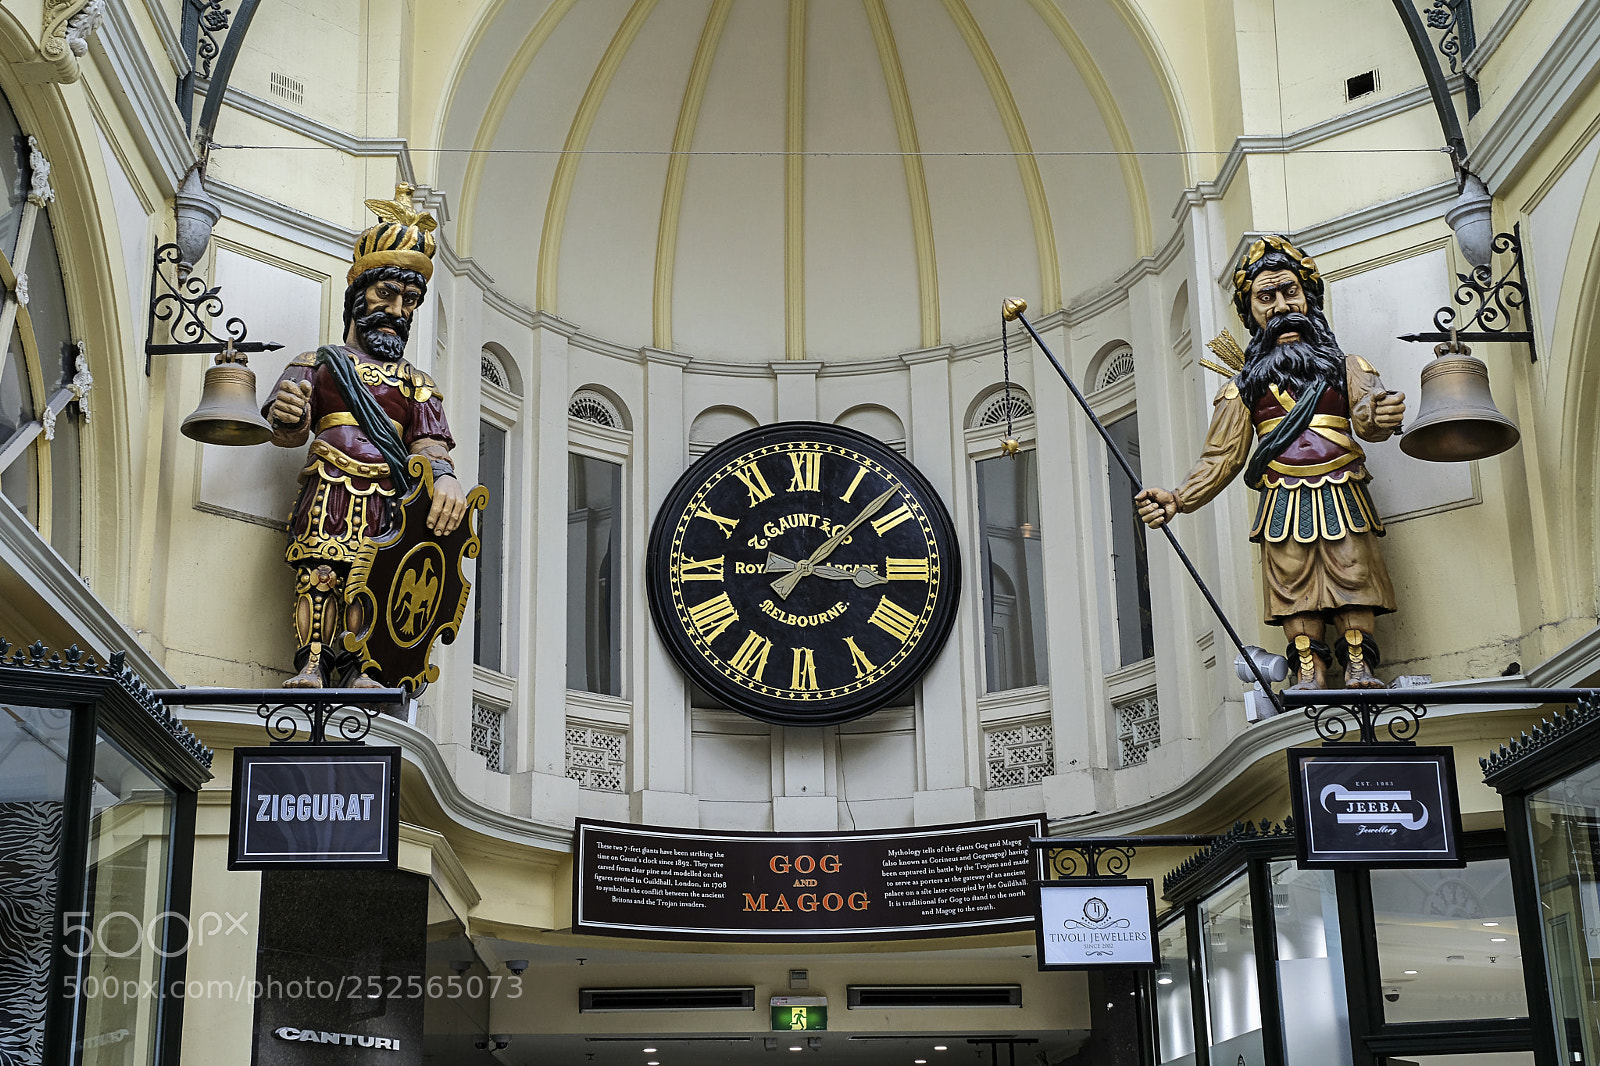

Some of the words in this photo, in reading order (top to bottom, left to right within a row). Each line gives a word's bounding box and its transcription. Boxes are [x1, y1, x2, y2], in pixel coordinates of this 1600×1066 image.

[786, 452, 824, 492] XII
[732, 461, 775, 508] XI
[839, 465, 870, 504] I
[694, 501, 740, 539] X
[764, 513, 820, 538] GAUNT
[870, 502, 914, 537] II
[886, 556, 929, 583] III
[688, 591, 740, 646] VIII
[868, 594, 920, 644] IIII
[727, 630, 774, 682] VII
[842, 636, 878, 678] V
[790, 646, 820, 691] VI
[256, 794, 374, 822] ZIGGURAT
[1346, 802, 1402, 812] JEEBA
[1356, 824, 1398, 836] Jewellery
[596, 842, 612, 850] These
[642, 847, 659, 855] giants
[674, 848, 688, 856] been
[690, 850, 714, 859] striking
[888, 848, 921, 858] Mythology
[956, 844, 974, 853] giants
[975, 842, 988, 850] Gog
[1002, 839, 1022, 848] Magog
[972, 849, 1008, 860] Gogmagog)
[675, 859, 692, 868] 1892.
[693, 860, 708, 869] They
[769, 854, 842, 874] GOG
[898, 868, 927, 878] captured
[955, 865, 962, 874] by
[974, 862, 1000, 870] Trojans
[594, 872, 613, 882] figures
[712, 882, 728, 890] 1708
[792, 879, 818, 888] AND
[920, 878, 943, 886] porters
[962, 874, 986, 883] gateway
[884, 890, 904, 899] palace
[949, 884, 976, 893] occupied
[949, 896, 962, 904] Gog
[612, 896, 632, 904] Britons
[656, 898, 678, 908] Trojan
[742, 892, 870, 912] MAGOG
[936, 908, 956, 916] Magog
[1049, 933, 1086, 942] TIVOLI
[1090, 932, 1148, 943] JEWELLERS
[275, 1026, 400, 1050] CANTURI
